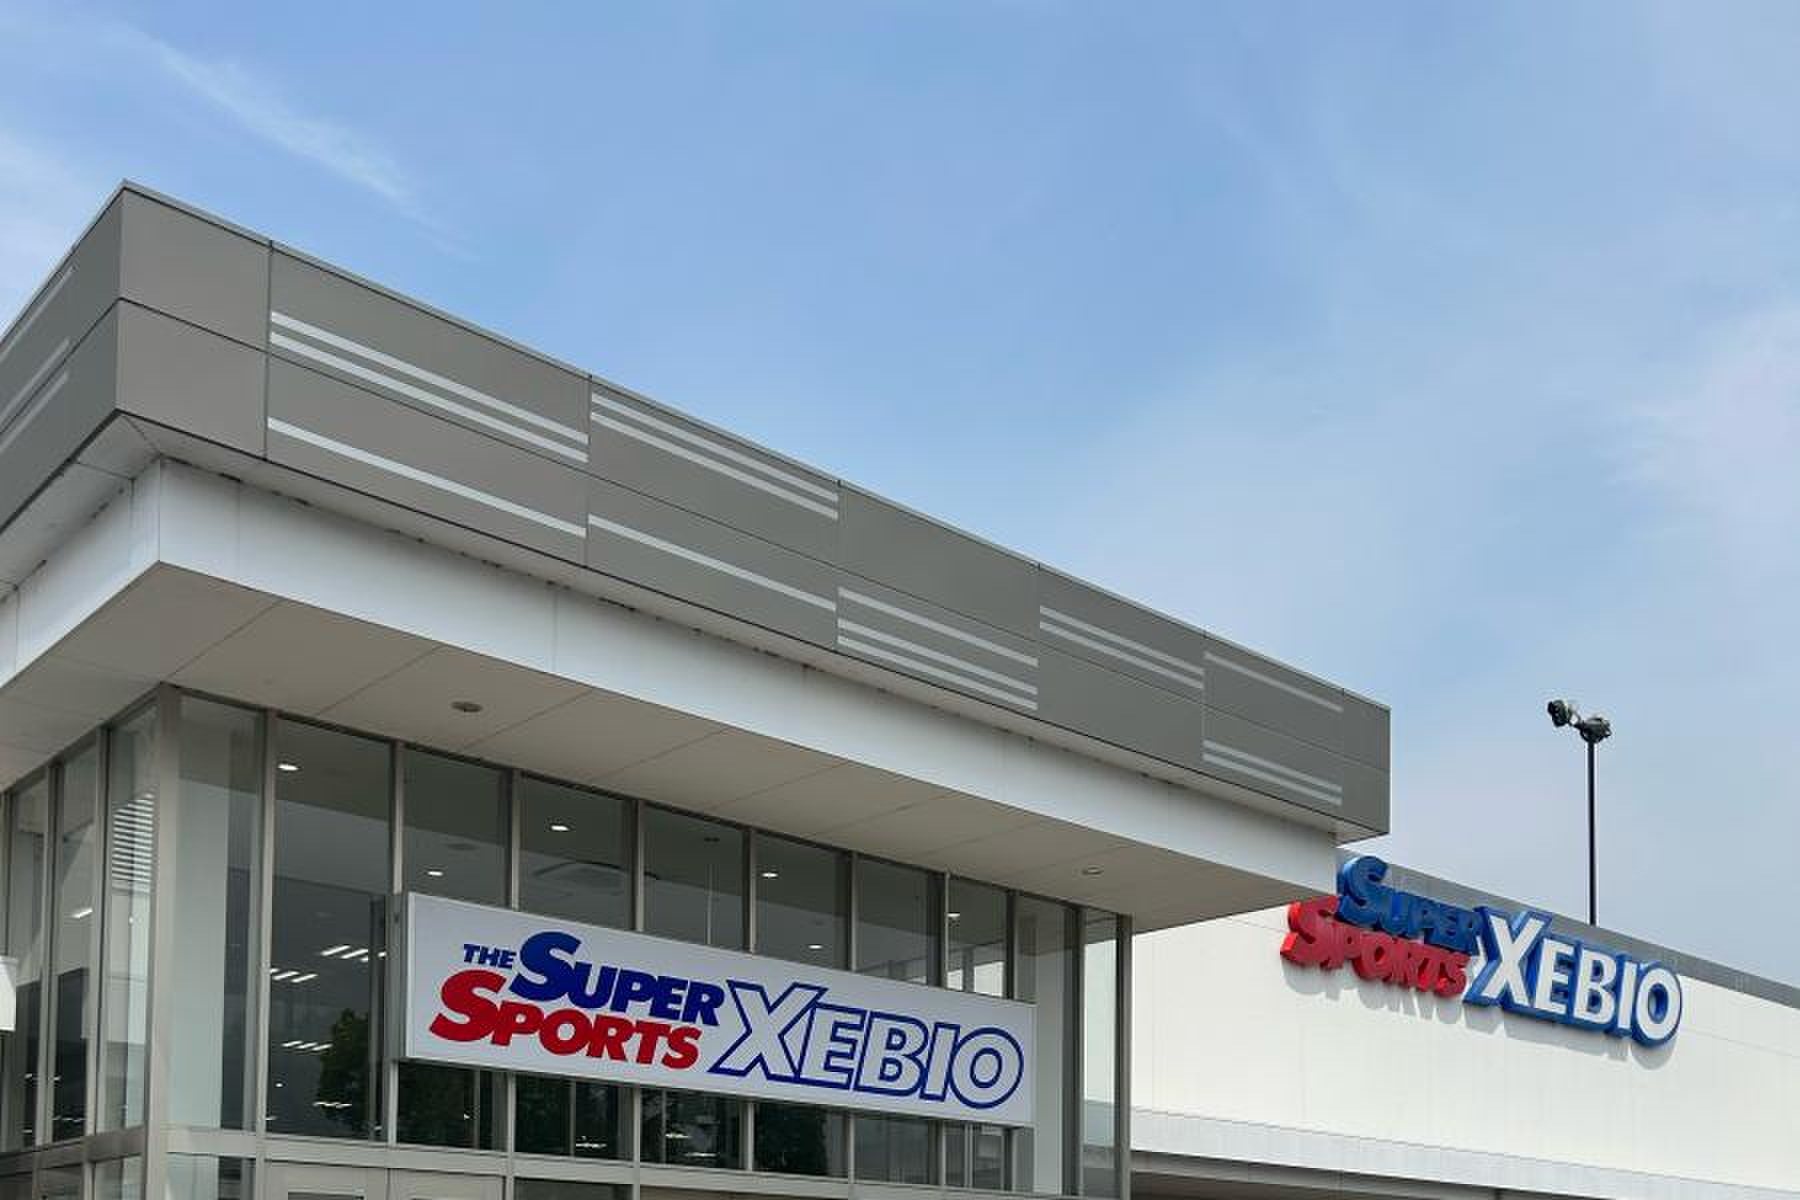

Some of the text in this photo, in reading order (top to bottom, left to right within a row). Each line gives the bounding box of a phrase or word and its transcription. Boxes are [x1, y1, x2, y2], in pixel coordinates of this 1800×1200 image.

[1280, 895, 1467, 997] SPORTS
[1336, 856, 1480, 957] SUPER
[429, 969, 703, 1071] SPORTS
[462, 931, 726, 1027] THE SUPER
[1462, 905, 1682, 1048] XEBIO
[706, 979, 1025, 1110] XEBIO
